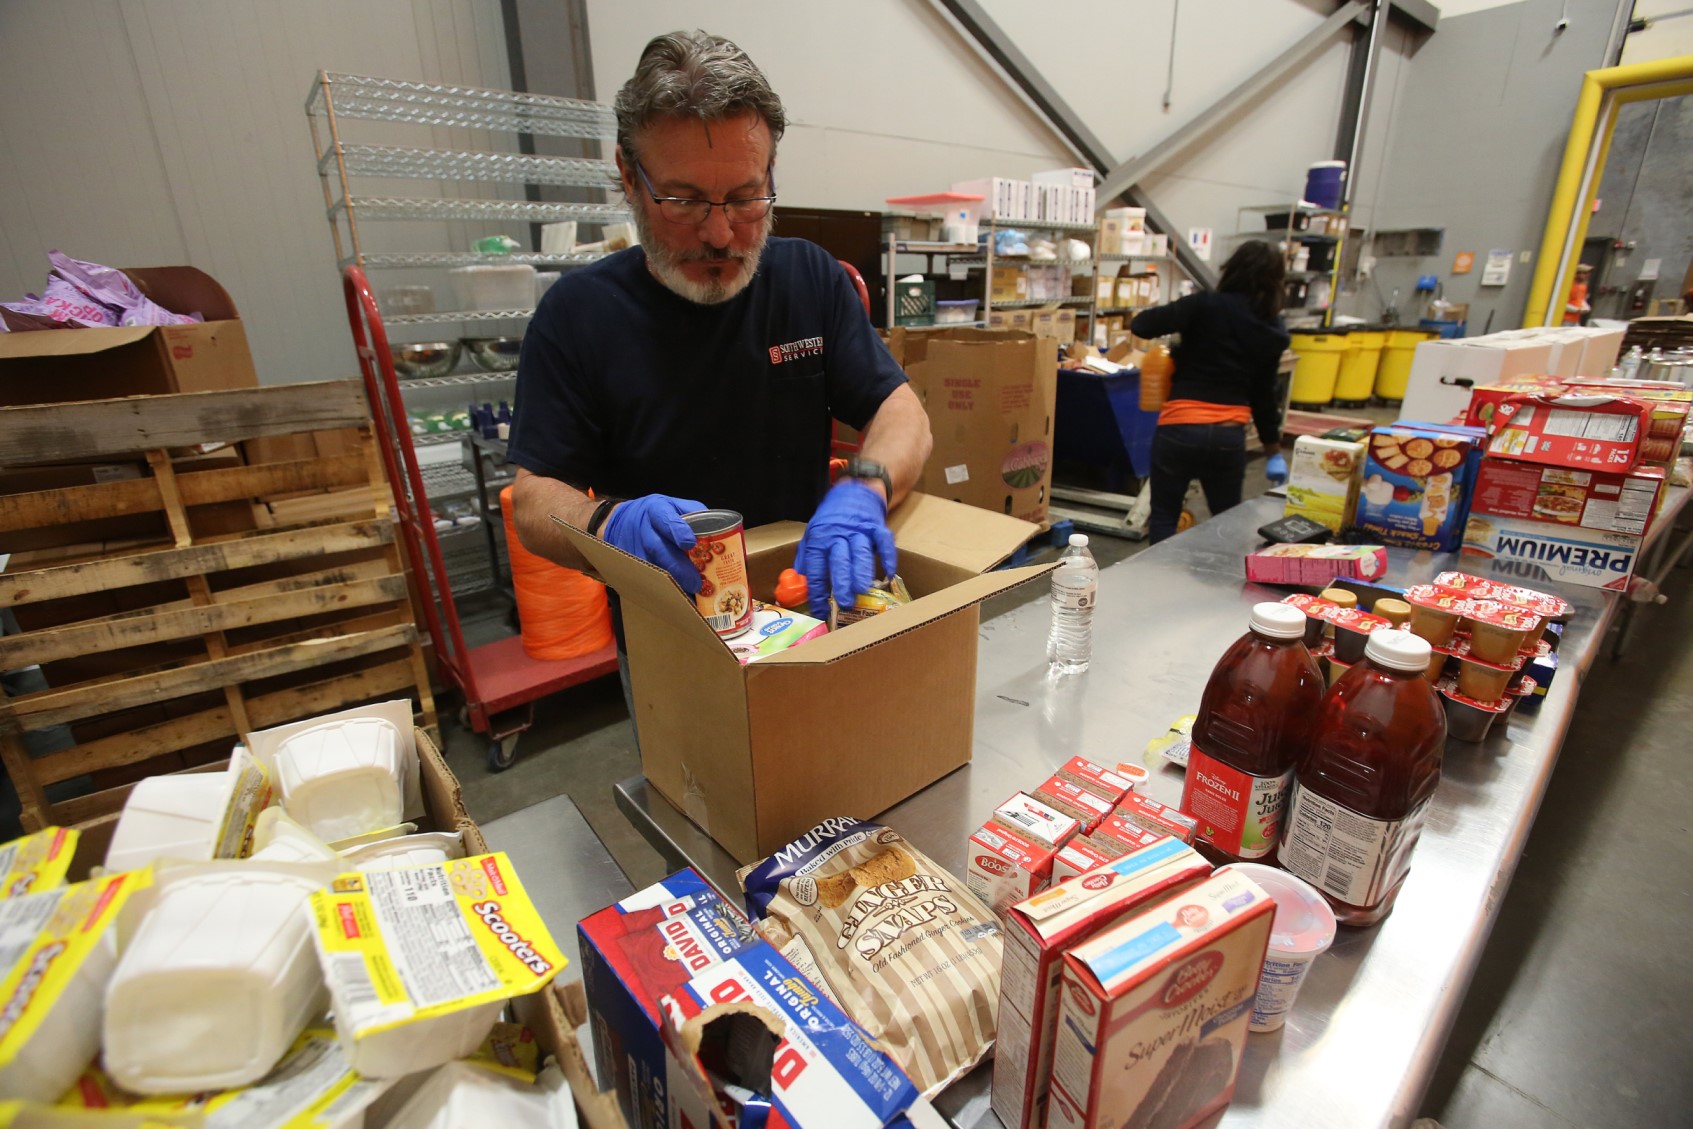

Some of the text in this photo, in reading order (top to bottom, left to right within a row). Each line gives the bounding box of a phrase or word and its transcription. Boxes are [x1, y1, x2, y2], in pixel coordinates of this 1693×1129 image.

[944, 378, 982, 388] SINGLE
[952, 390, 972, 399] USE
[948, 401, 975, 411] ONLY
[1614, 449, 1628, 464] 12
[1496, 536, 1632, 573] PREMIUM
[1196, 771, 1240, 801] FROZEN II
[1319, 820, 1331, 831] 120
[1321, 805, 1335, 816] Facts
[774, 816, 859, 869] MURRAY
[800, 833, 863, 876] Baked with Pride
[981, 857, 1007, 872] BOOS
[404, 887, 418, 902] 110
[837, 874, 952, 949] GINGER
[473, 900, 550, 977] Scooters
[694, 909, 732, 955] ORIGINAL
[711, 913, 736, 942] Jumbo
[855, 895, 957, 961] SNAPS
[662, 917, 711, 973] DAVID
[872, 960, 888, 974] Old
[888, 937, 925, 962] Fashioned
[925, 924, 951, 940] Ginger
[950, 914, 975, 927] Cookies
[783, 977, 819, 1007] Jumbo
[910, 976, 923, 988] NET
[922, 972, 934, 983] WT
[764, 970, 820, 1028] ORIGINAL
[1125, 990, 1232, 1071] SuperMoist
